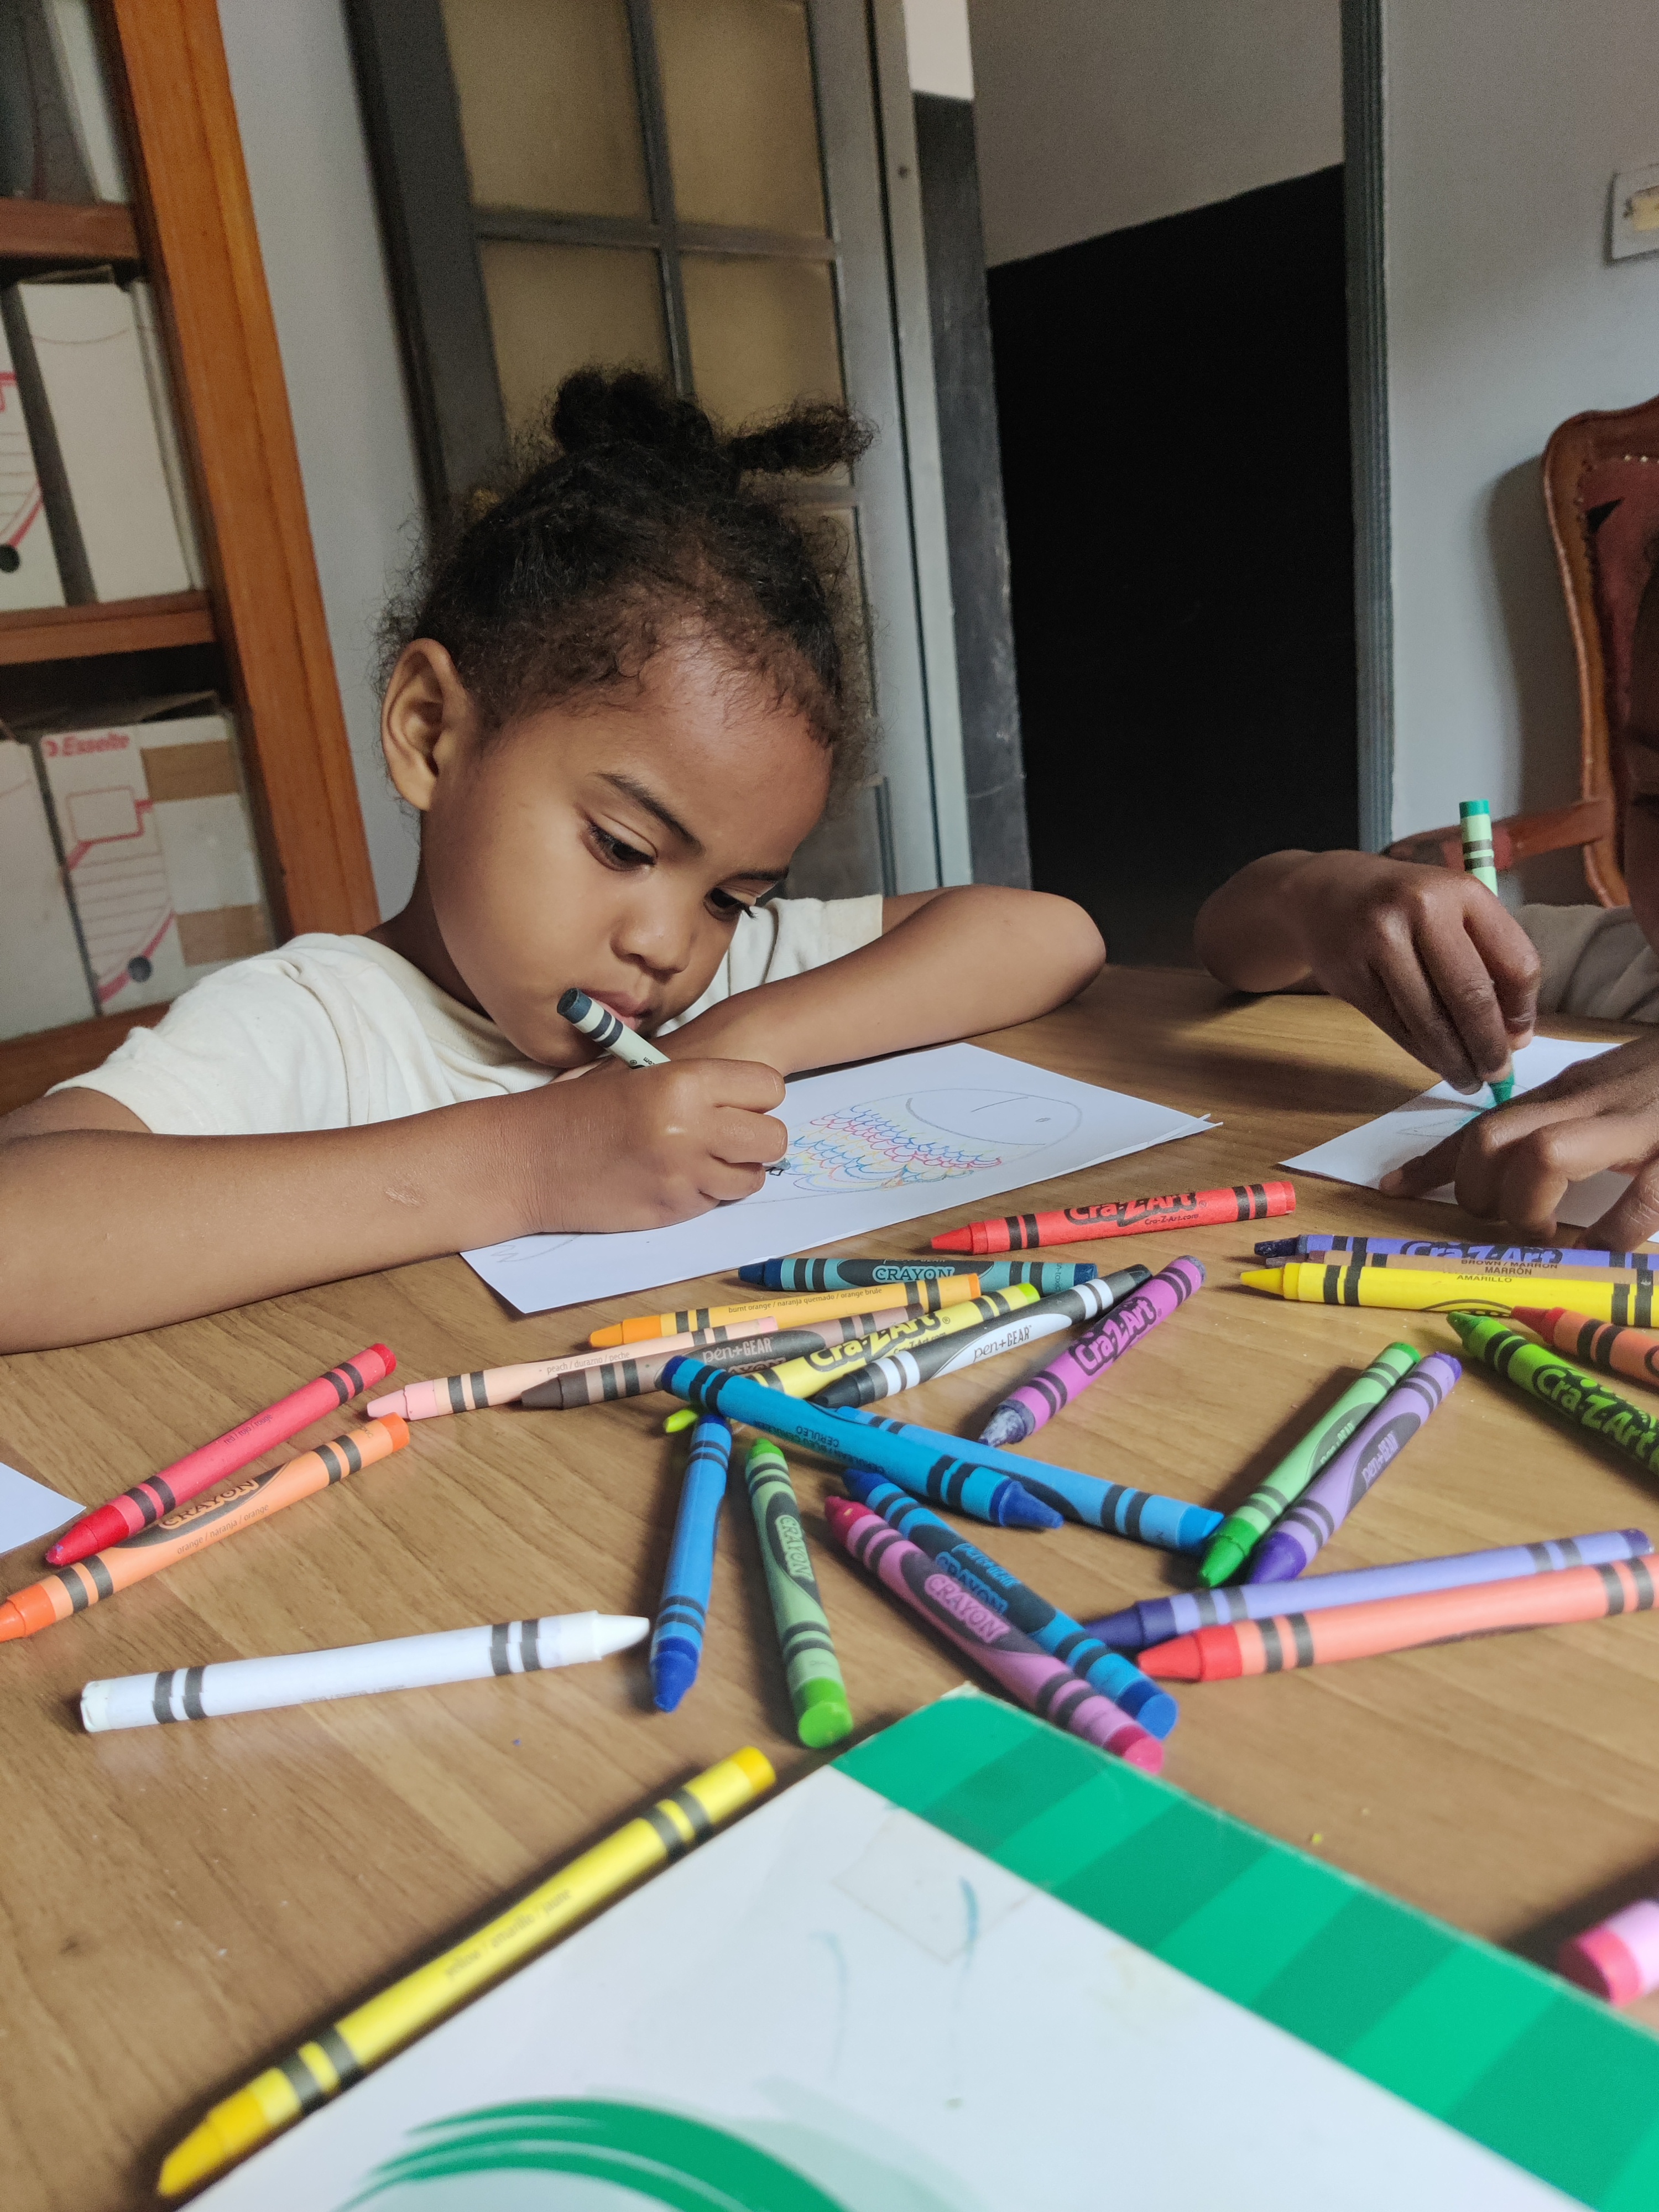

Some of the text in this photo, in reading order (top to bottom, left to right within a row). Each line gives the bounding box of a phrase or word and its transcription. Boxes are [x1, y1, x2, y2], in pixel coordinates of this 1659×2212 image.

[874, 1267, 954, 1281] CRAYON
[1457, 1274, 1512, 1283] AMARILLO
[748, 1303, 771, 1312] orange
[777, 1299, 802, 1307] naranja
[804, 1294, 835, 1305] quemado
[841, 1291, 864, 1300] orange
[973, 1326, 1030, 1363] pen+GEAR
[1075, 1299, 1155, 1370] Cra-Z-Art
[546, 1362, 568, 1375] peach
[574, 1357, 603, 1368] durazno
[702, 1338, 773, 1364] pen+GEAR
[223, 1435, 236, 1445] red
[238, 1426, 252, 1437] rojo
[254, 1414, 273, 1426] rouge
[796, 1426, 840, 1448] CERULEO
[161, 1480, 257, 1528] CRAYON
[177, 1536, 204, 1554] orange
[210, 1520, 238, 1538] naranja
[243, 1503, 269, 1521] orange
[777, 1516, 813, 1578] CRAYON
[927, 1577, 1008, 1641] CRAYON
